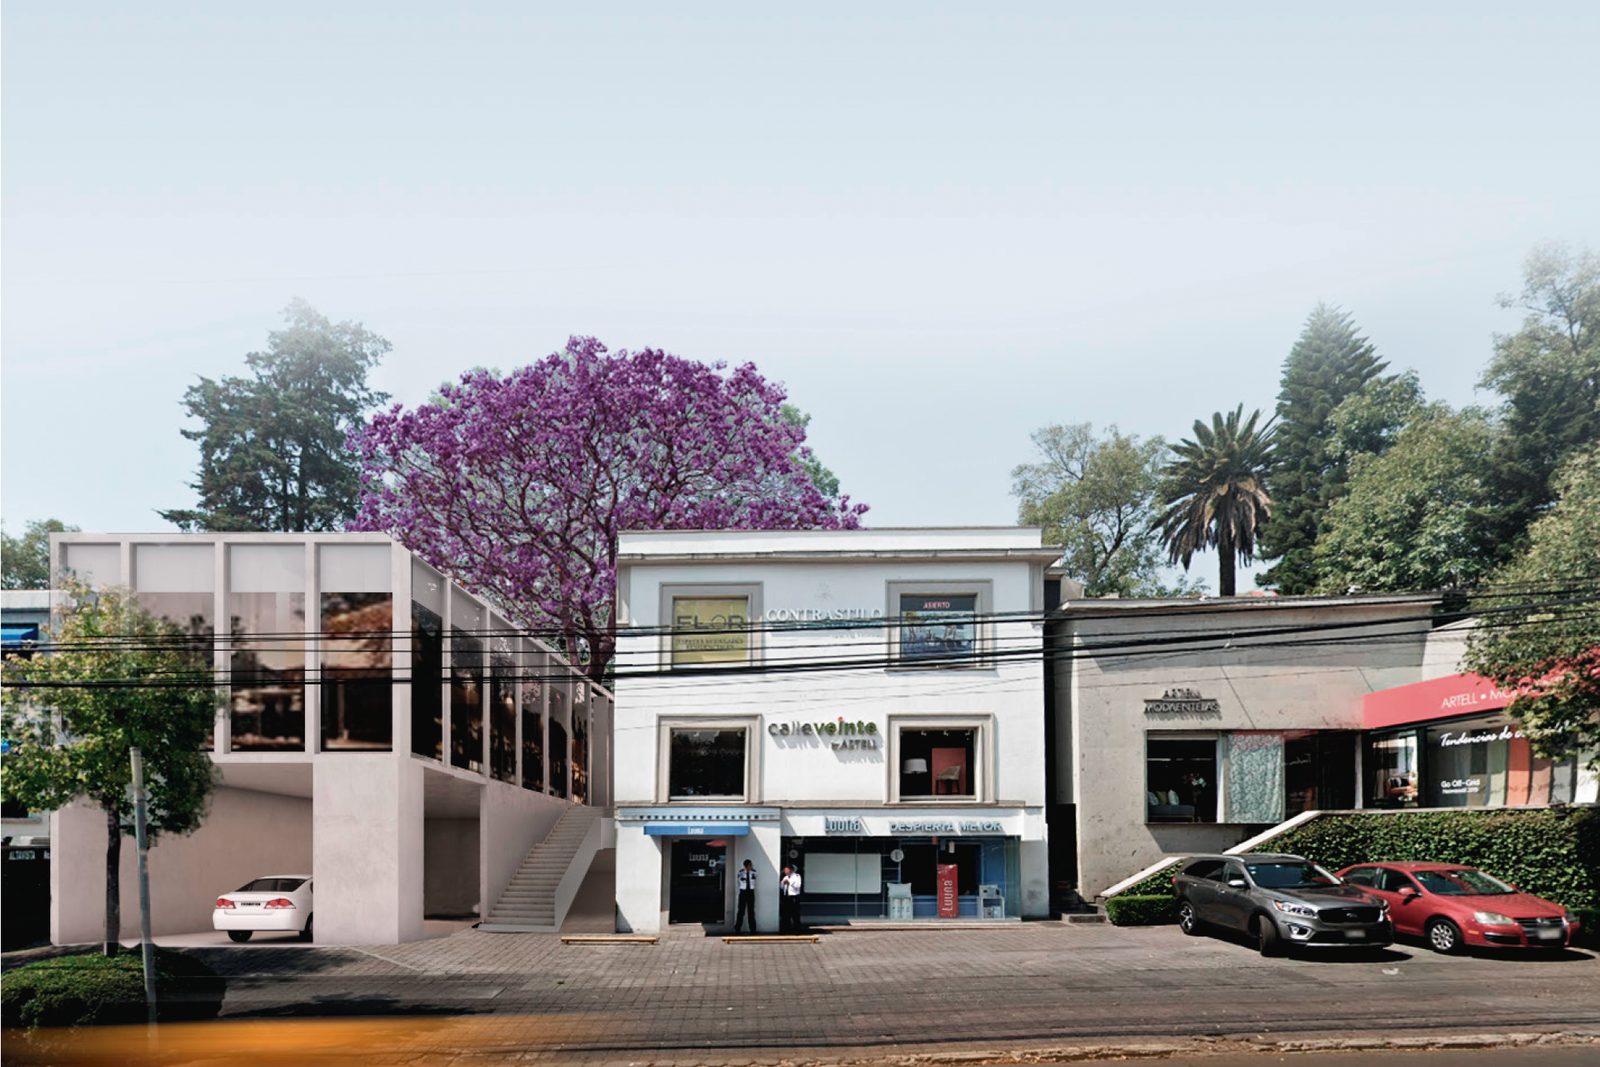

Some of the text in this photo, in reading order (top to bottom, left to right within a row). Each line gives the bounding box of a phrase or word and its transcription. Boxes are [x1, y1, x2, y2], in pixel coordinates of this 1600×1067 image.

[677, 615, 744, 631] FLOR
[1441, 692, 1479, 709] ARTELL
[1440, 731, 1497, 747] Tendencias
[1499, 725, 1513, 740] de
[1441, 780, 1451, 788] Go
[890, 821, 955, 833] DESPIERTA
[942, 879, 954, 912] Luuna
